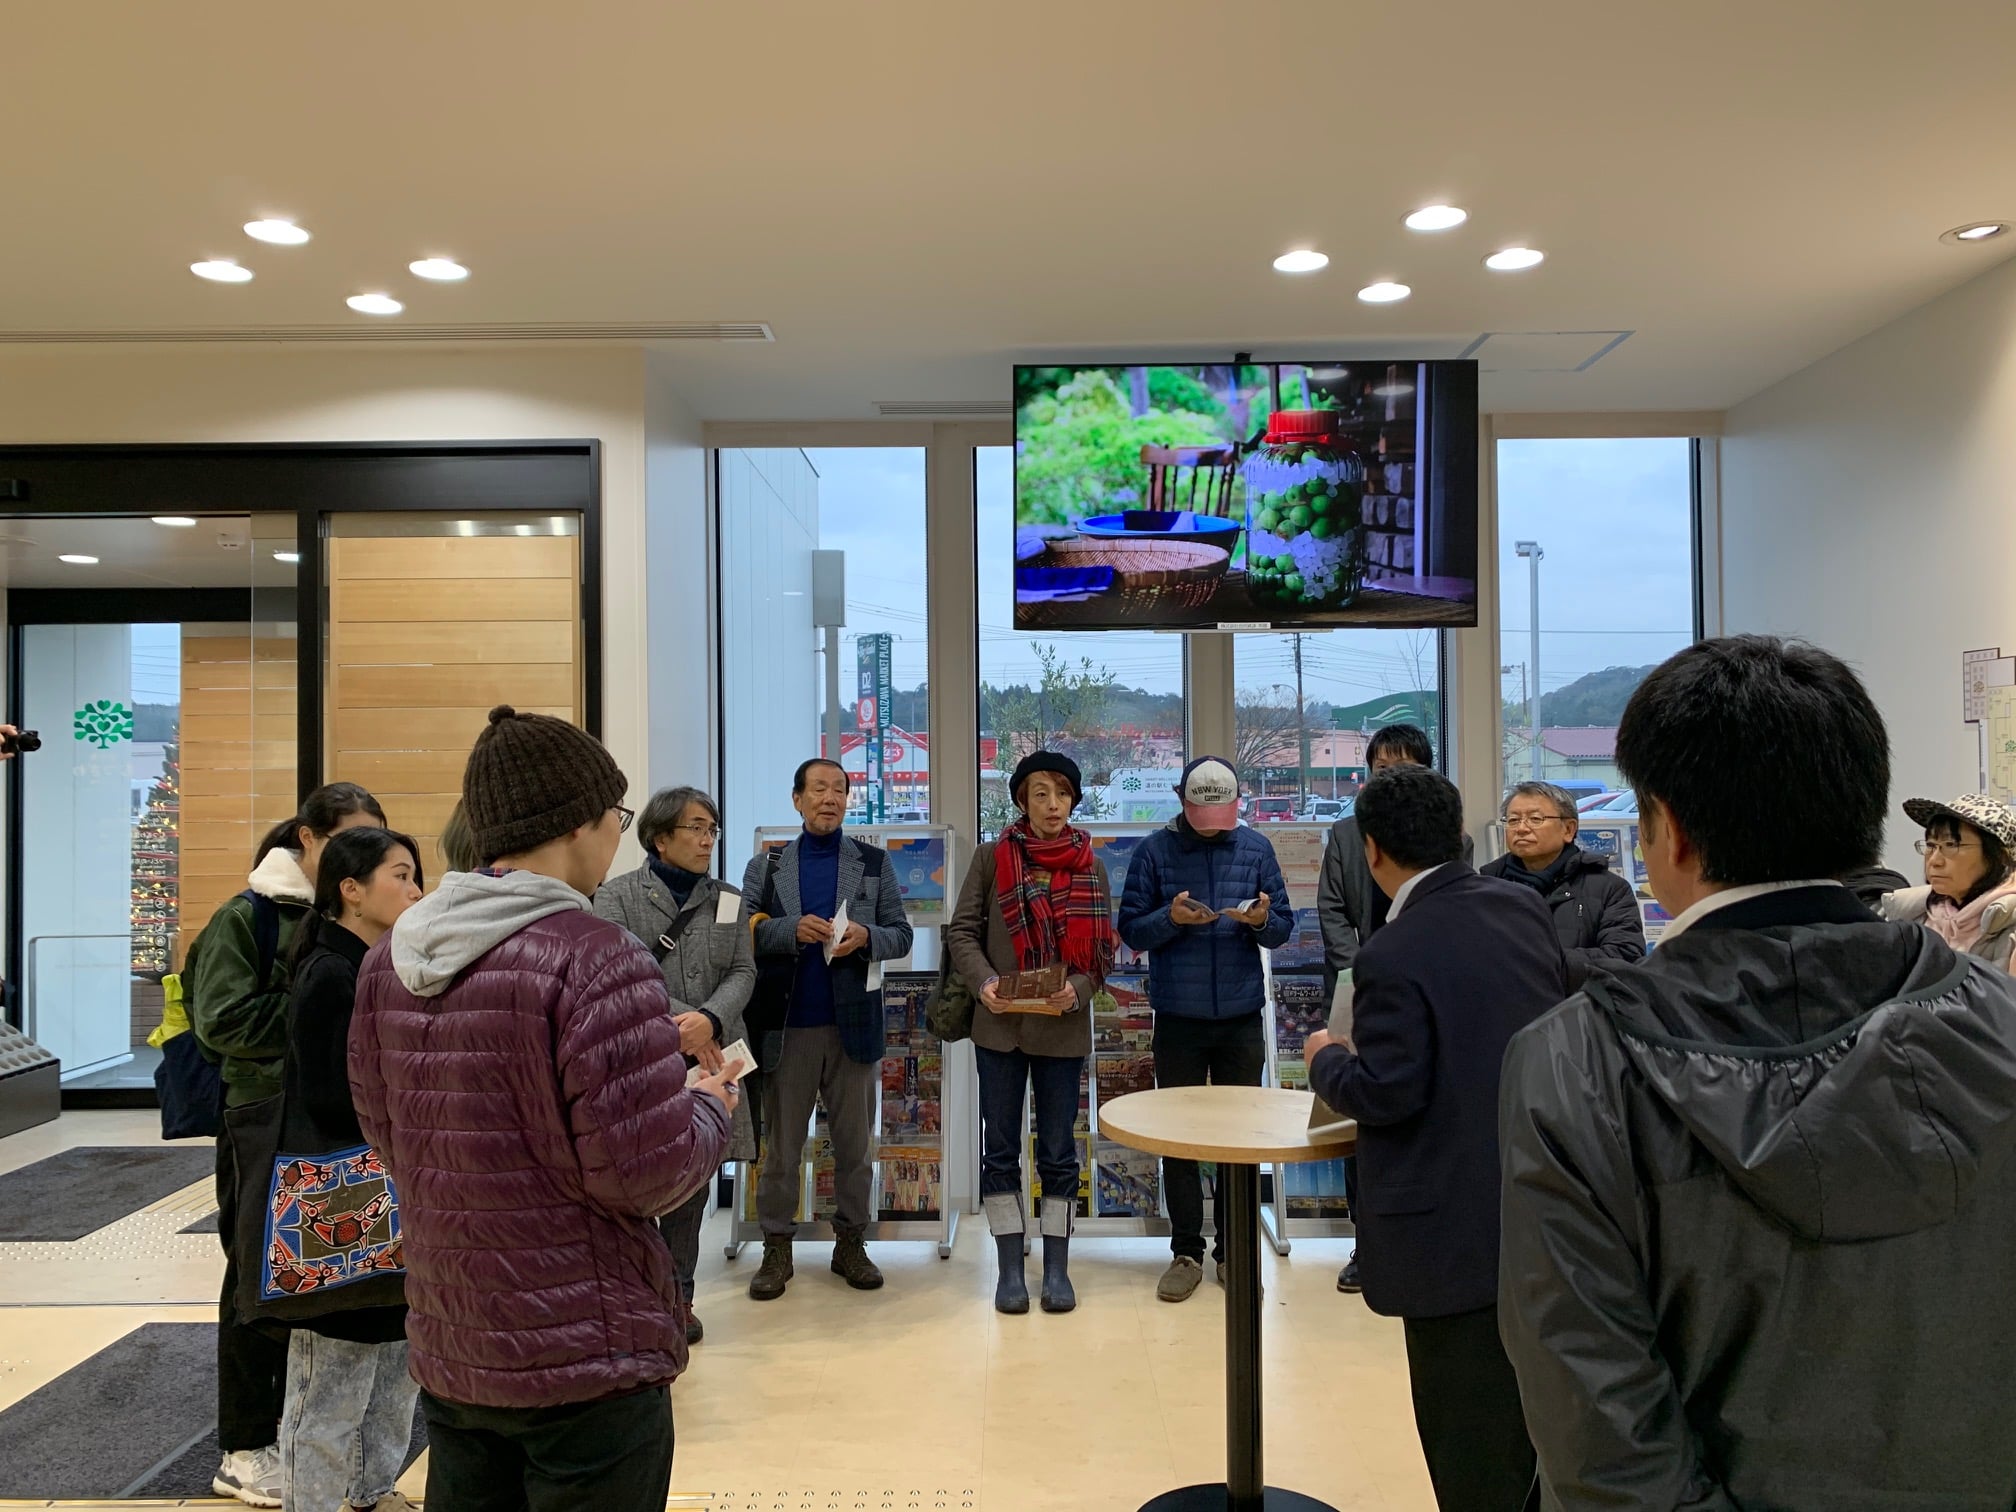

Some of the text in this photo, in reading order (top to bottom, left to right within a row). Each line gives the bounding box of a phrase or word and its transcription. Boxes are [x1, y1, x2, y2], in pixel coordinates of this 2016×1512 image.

[862, 671, 871, 689] D2
[879, 634, 890, 727] MUTSUZAWA MARKET PLACE
[1191, 785, 1212, 796] NEW
